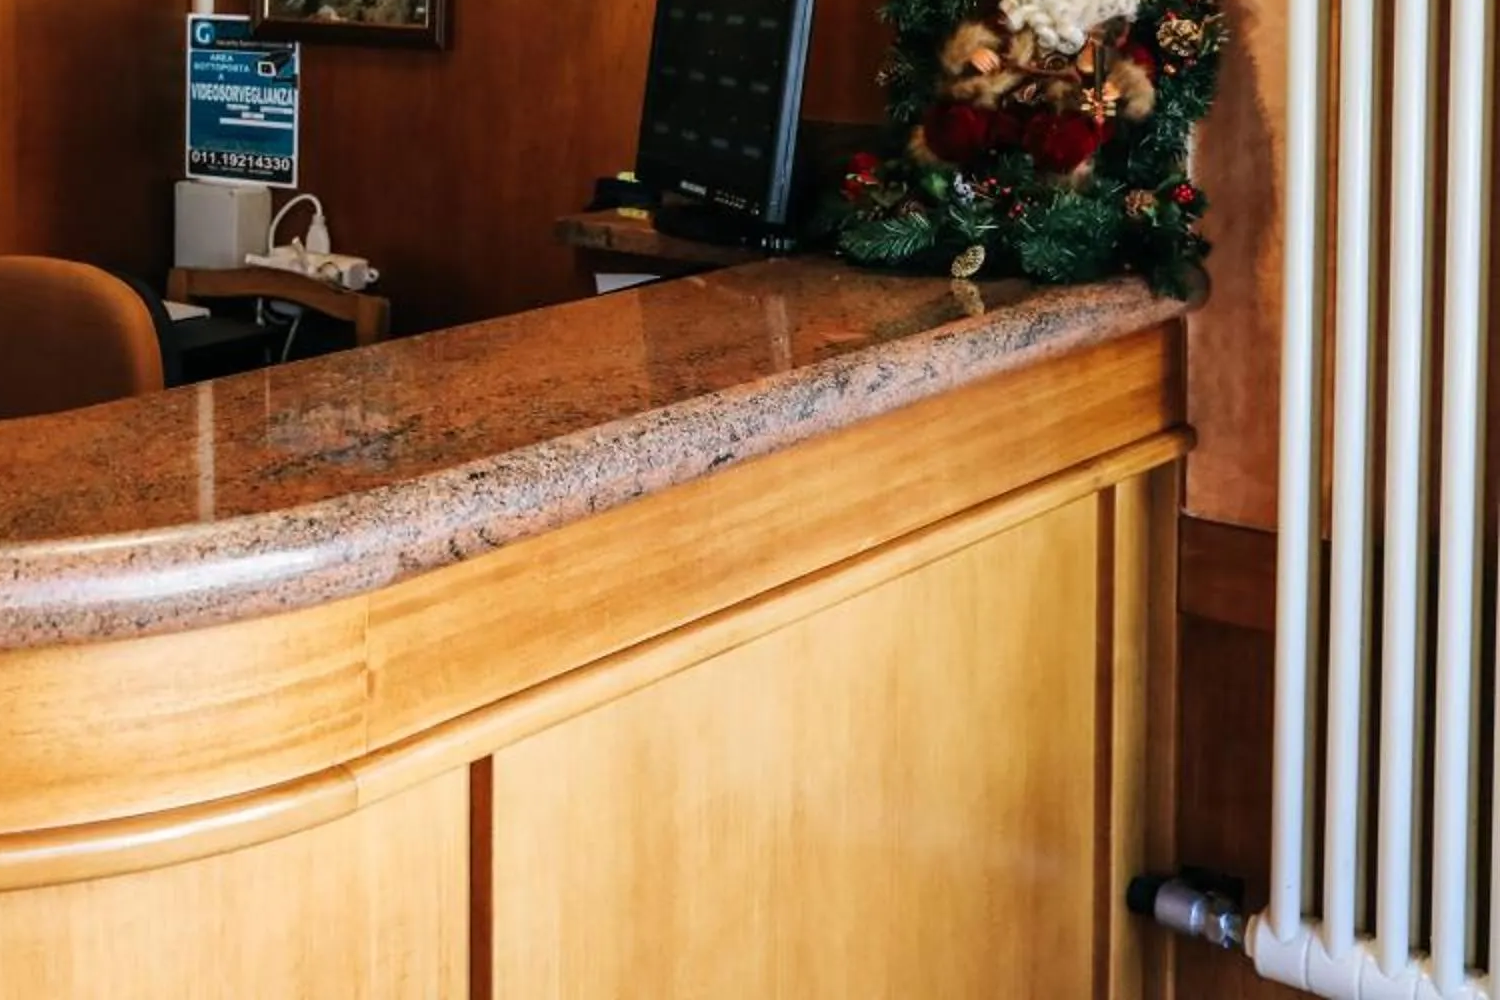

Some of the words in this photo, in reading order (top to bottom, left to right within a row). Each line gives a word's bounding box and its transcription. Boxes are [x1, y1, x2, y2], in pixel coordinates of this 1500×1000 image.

[209, 53, 234, 62] AREA
[193, 61, 250, 73] SOTTOPOSTA
[191, 82, 293, 106] VIDEOSORVEGLIANZA
[191, 150, 291, 172] 011.19214330
